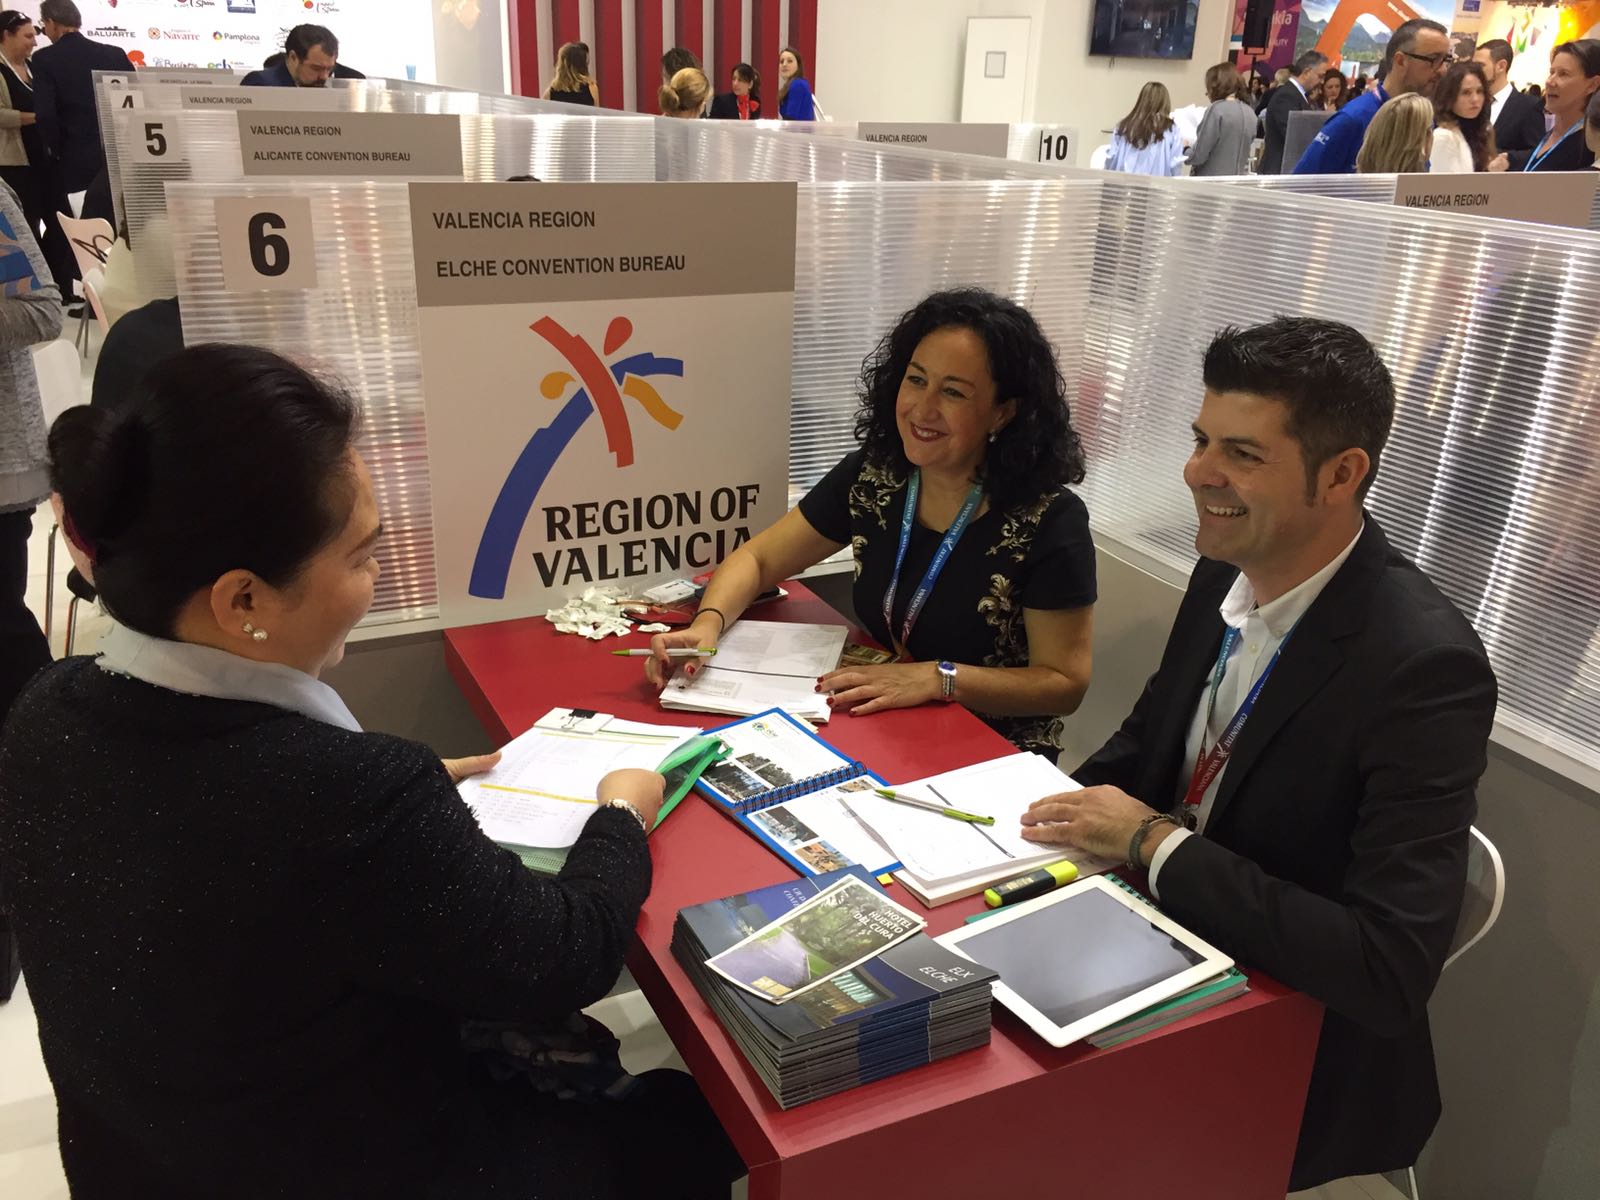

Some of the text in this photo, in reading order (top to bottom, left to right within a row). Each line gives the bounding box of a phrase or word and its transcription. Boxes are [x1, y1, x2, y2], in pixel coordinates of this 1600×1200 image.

[87, 30, 136, 38] BALUARTE
[163, 30, 200, 40] Navarre
[224, 32, 260, 43] Pamplona
[189, 96, 253, 105] VALENCIA REGION
[144, 122, 167, 156] 5
[249, 125, 342, 137] VALENCIA REGION
[865, 133, 928, 143] VALENCIA REGION
[253, 151, 411, 162] ALICANTE CONVENTION BUREAU
[1043, 134, 1068, 161] 10
[1405, 193, 1490, 207] VALENCIA REGION
[432, 210, 596, 229] VALENCIA REGION
[247, 211, 291, 277] 6
[436, 255, 686, 277] ELCHE CONVENTION BUREAU
[541, 484, 760, 542] REGION OF
[1223, 712, 1248, 748] COMUNITAT
[853, 912, 894, 940] DEL CURA
[868, 911, 904, 934] HUERTO
[884, 909, 912, 930] HOTEL
[919, 966, 958, 984] ELCHE
[949, 966, 975, 979] ELX
